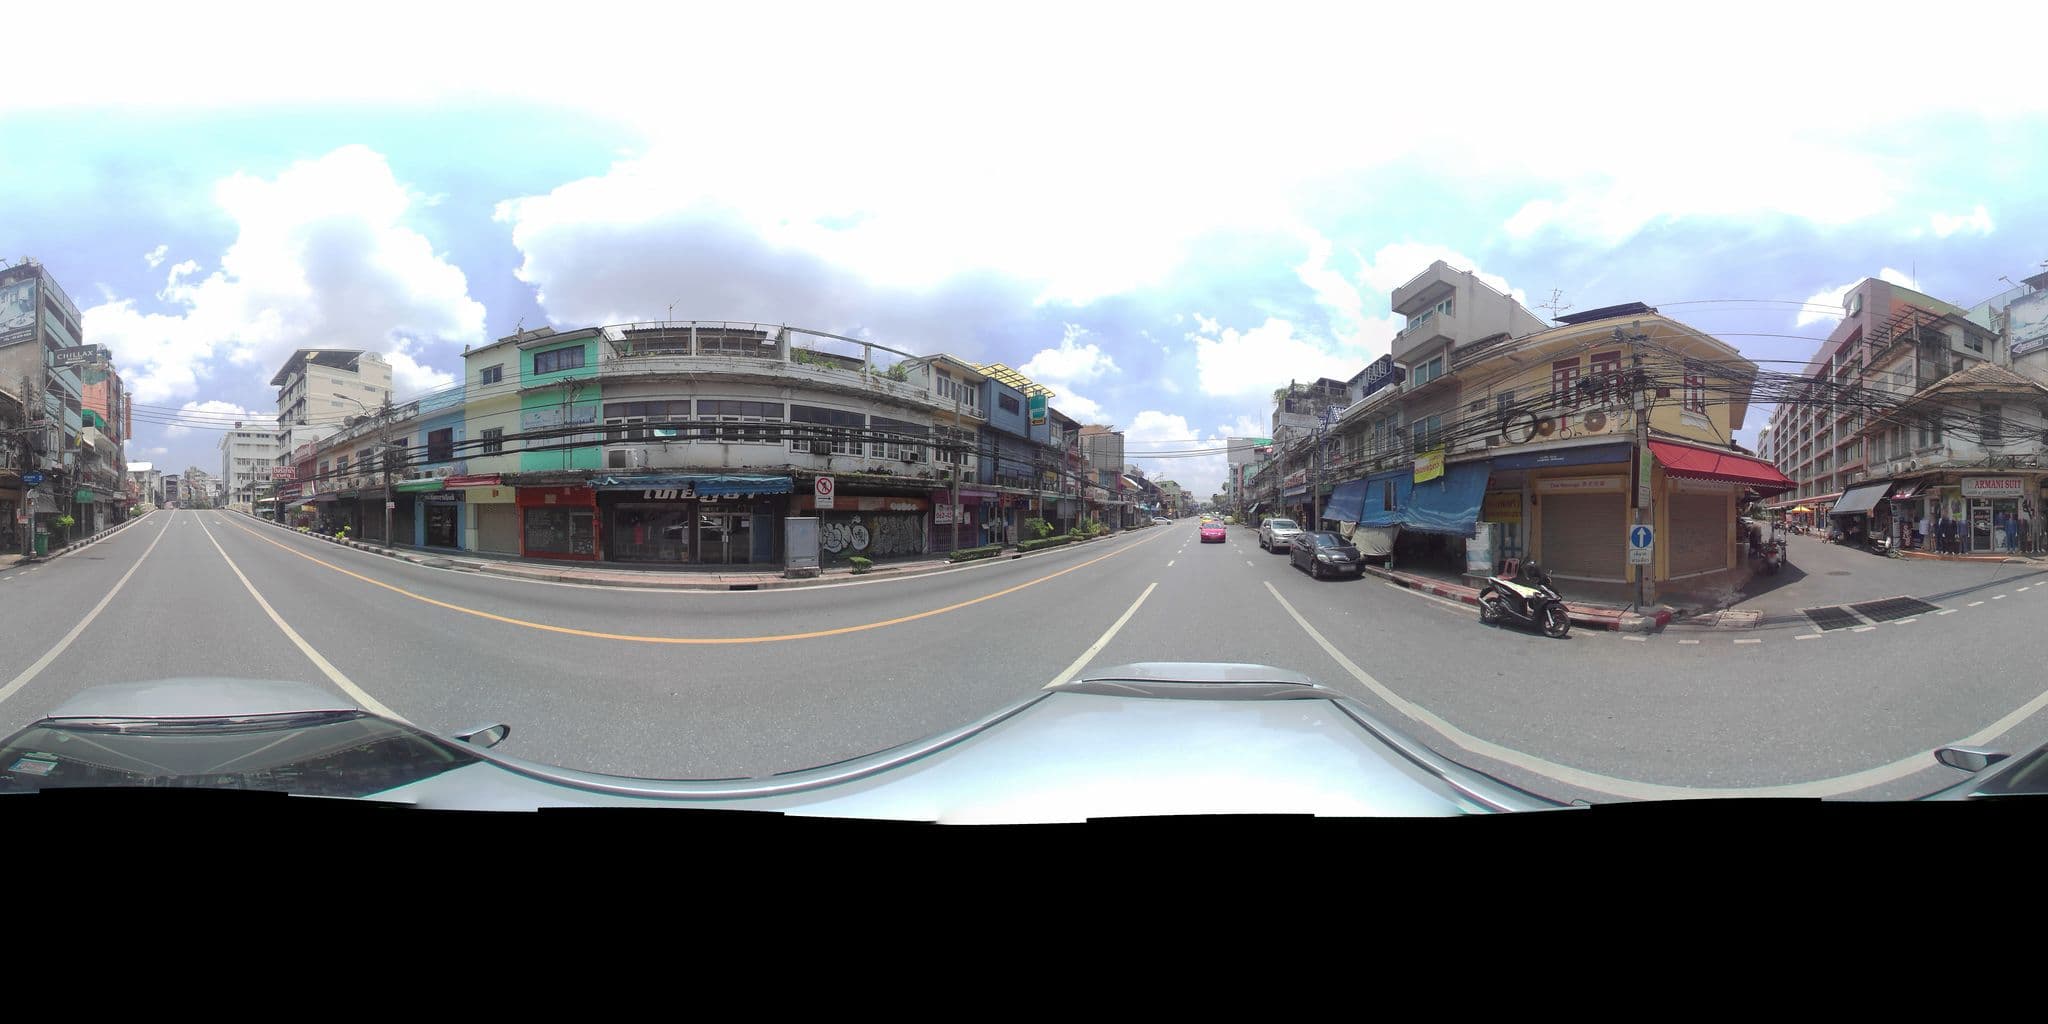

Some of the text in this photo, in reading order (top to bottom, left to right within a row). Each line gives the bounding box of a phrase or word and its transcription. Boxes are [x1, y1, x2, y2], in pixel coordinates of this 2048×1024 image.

[57, 350, 94, 360] CHILLAX
[1975, 480, 2021, 489] ARMANI SUIT
